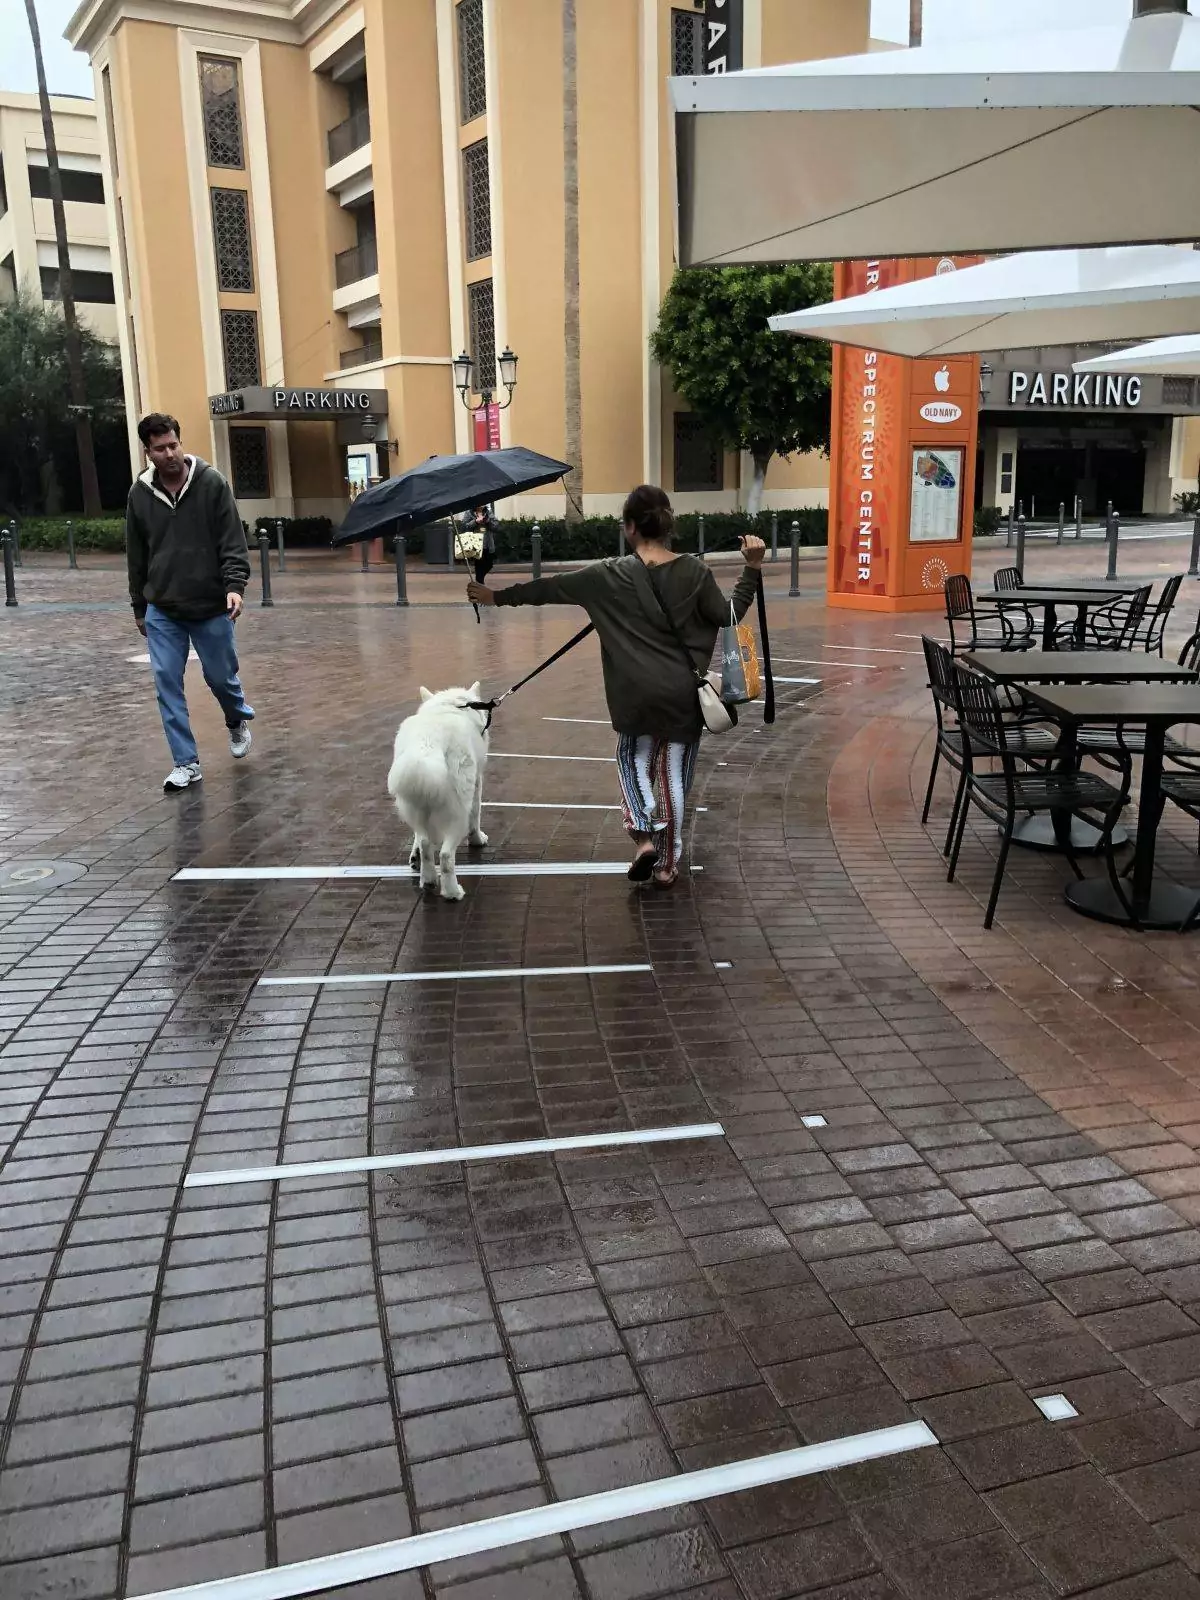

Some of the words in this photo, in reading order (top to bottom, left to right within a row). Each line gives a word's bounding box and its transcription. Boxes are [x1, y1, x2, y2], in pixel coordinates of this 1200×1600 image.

[275, 391, 370, 409] PARKING
[1010, 371, 1141, 406] PARKING
[211, 394, 241, 415] PARKING
[861, 352, 877, 480] SPECTRUM
[924, 407, 938, 417] OLD
[939, 407, 958, 418] NAVY
[858, 490, 873, 580] CENTER
